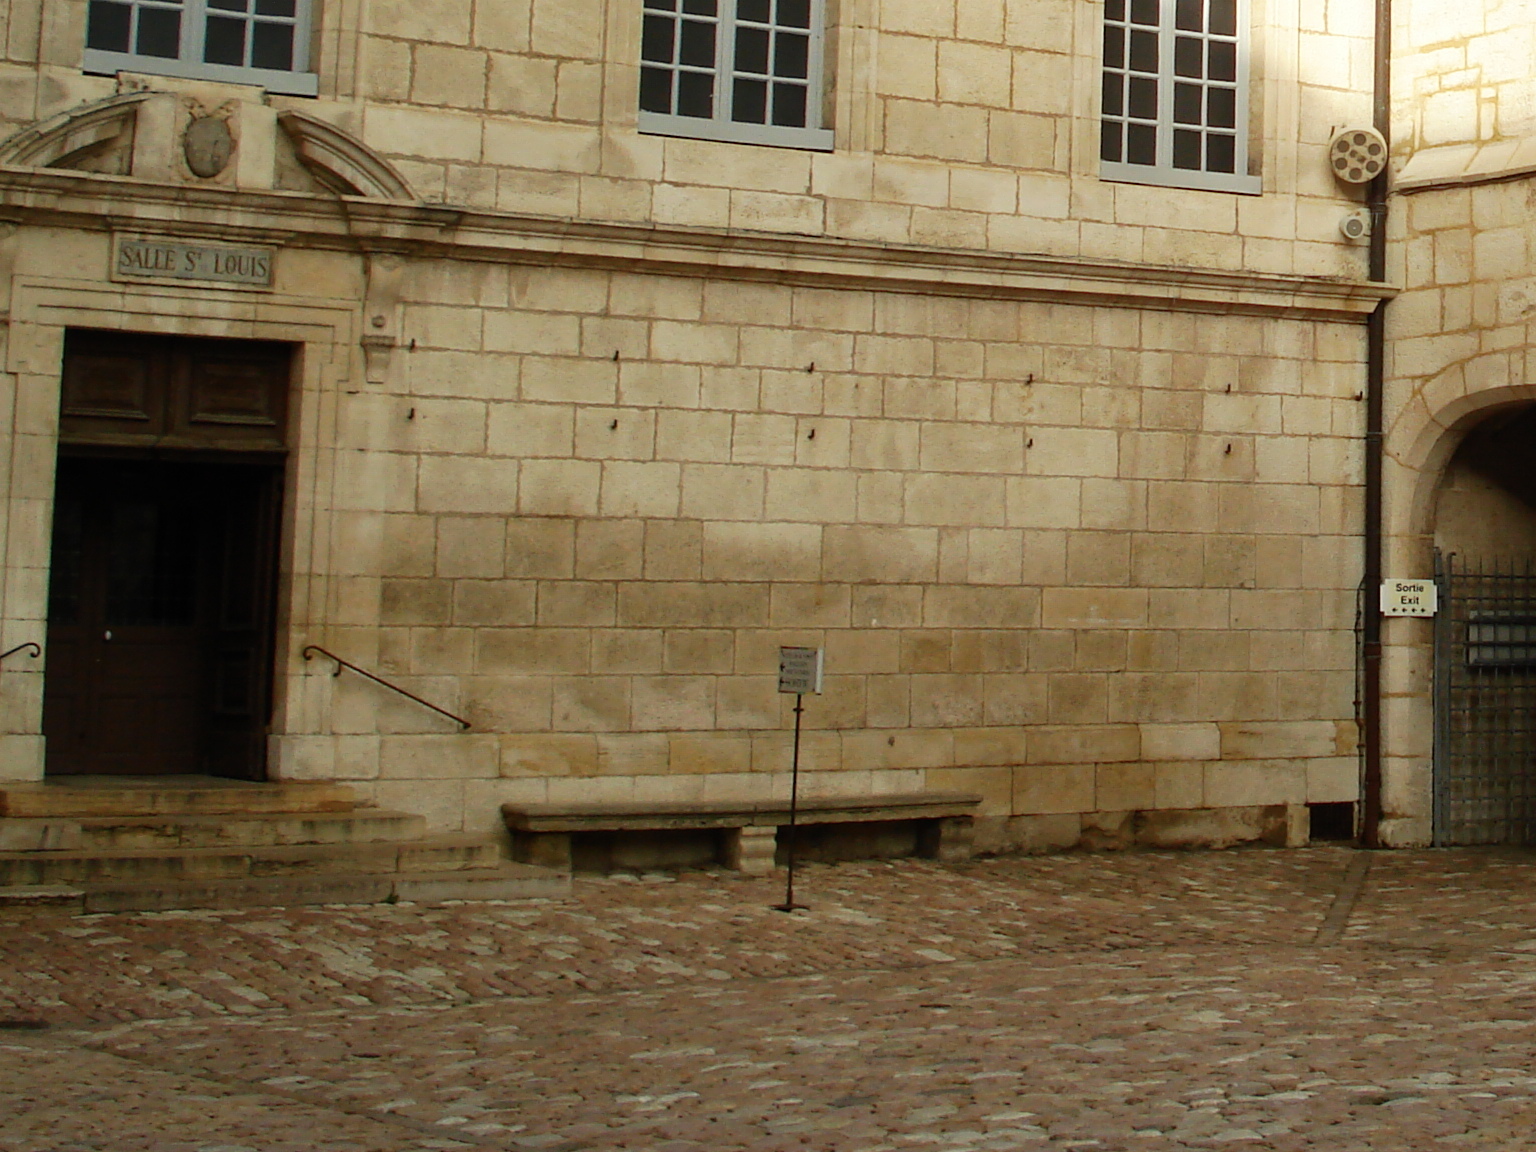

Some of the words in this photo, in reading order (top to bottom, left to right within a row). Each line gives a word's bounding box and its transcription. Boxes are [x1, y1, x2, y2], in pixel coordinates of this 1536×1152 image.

[120, 246, 176, 271] SALLE
[213, 252, 268, 278] LOUIS
[1395, 583, 1425, 593] Sortie
[1400, 595, 1420, 605] Exit
